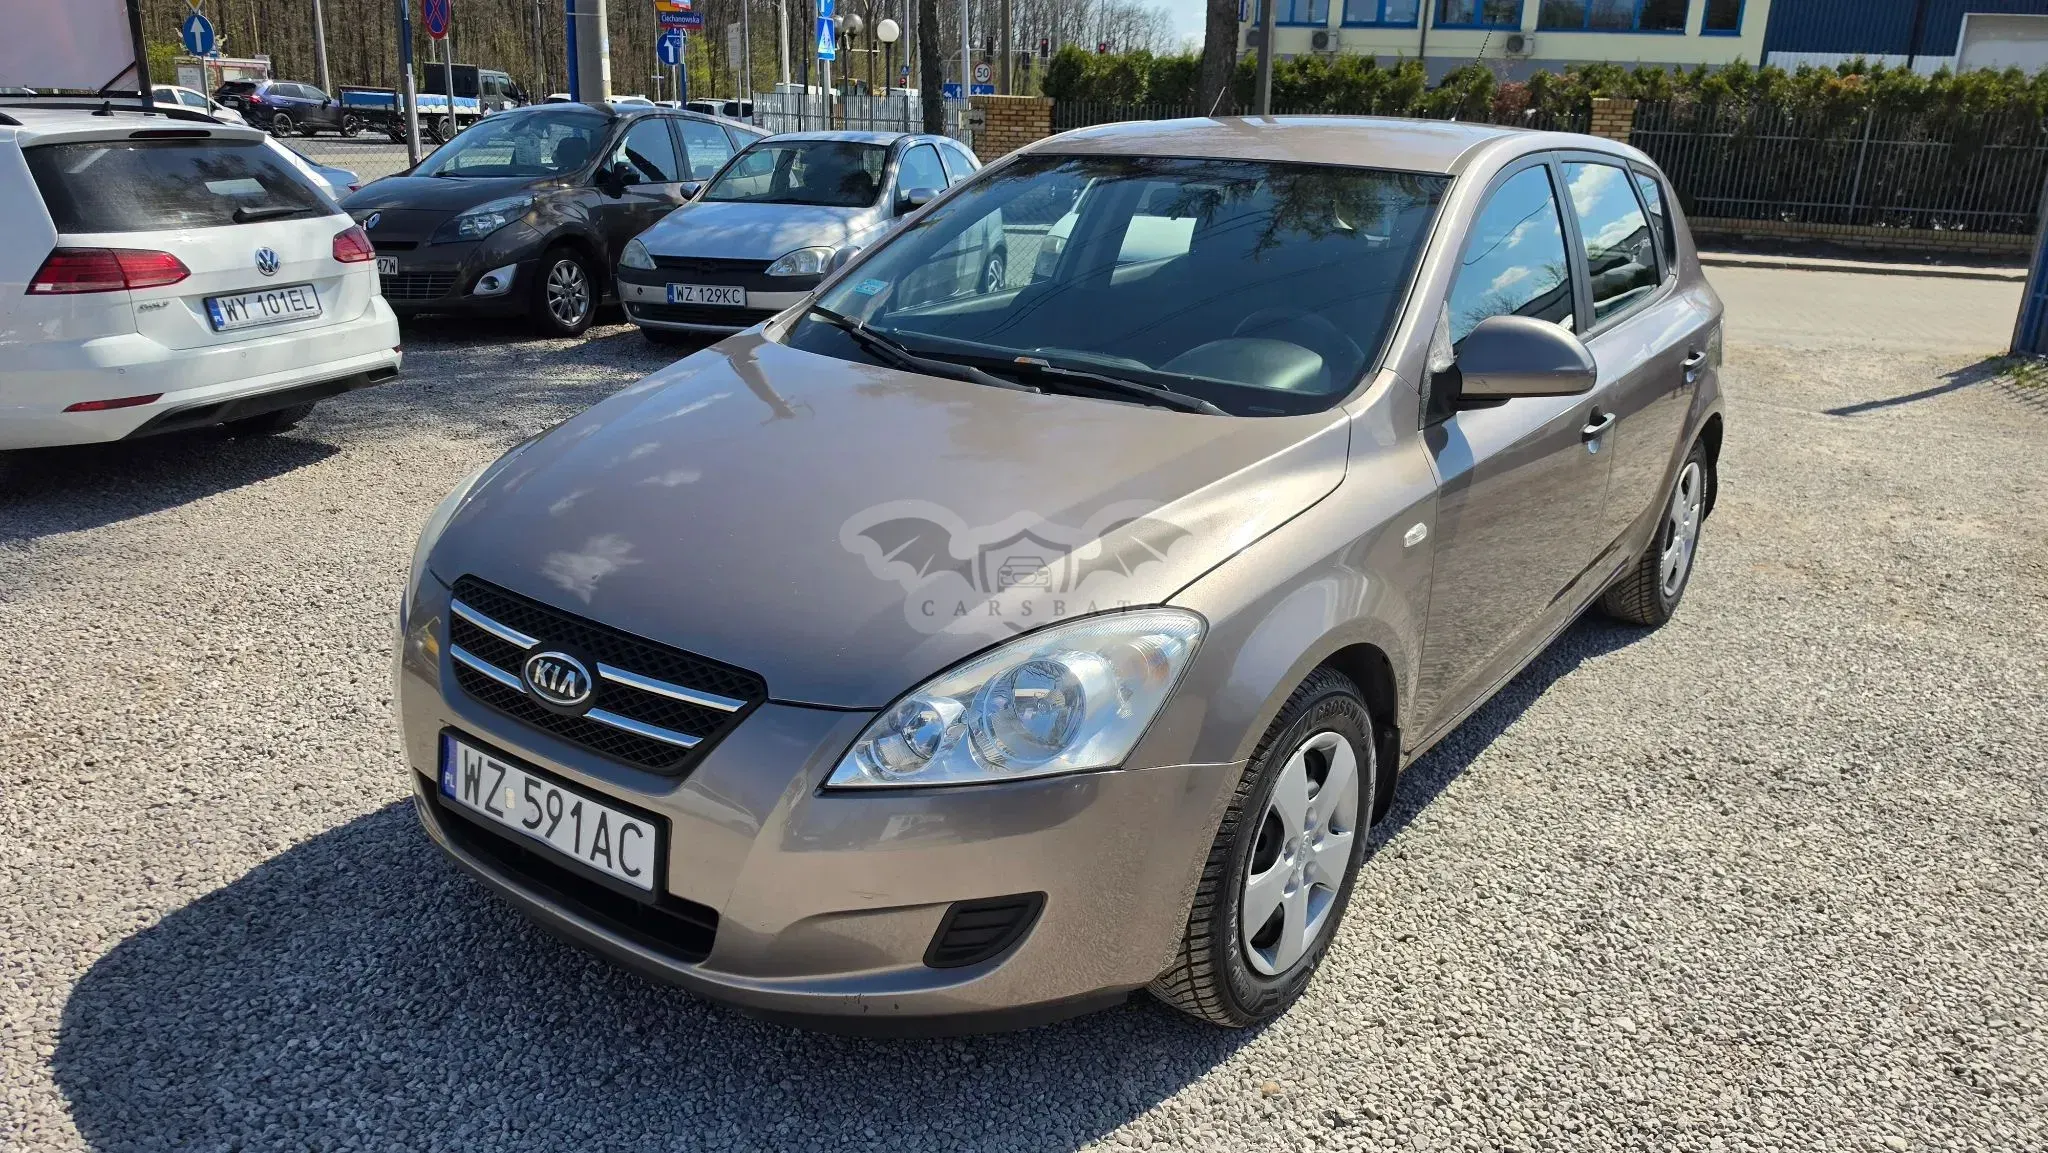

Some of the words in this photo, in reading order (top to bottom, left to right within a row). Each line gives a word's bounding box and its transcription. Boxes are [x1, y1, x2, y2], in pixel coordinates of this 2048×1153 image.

[661, 14, 700, 24] Ciechanowska
[977, 67, 989, 78] 50
[675, 286, 694, 302] WZ
[699, 287, 741, 304] 129KC
[221, 295, 249, 322] WY
[256, 289, 315, 317] 101EL
[534, 659, 576, 698] KIA
[443, 771, 456, 789] PL
[463, 749, 507, 819] WZ
[521, 776, 644, 878] 591AC
